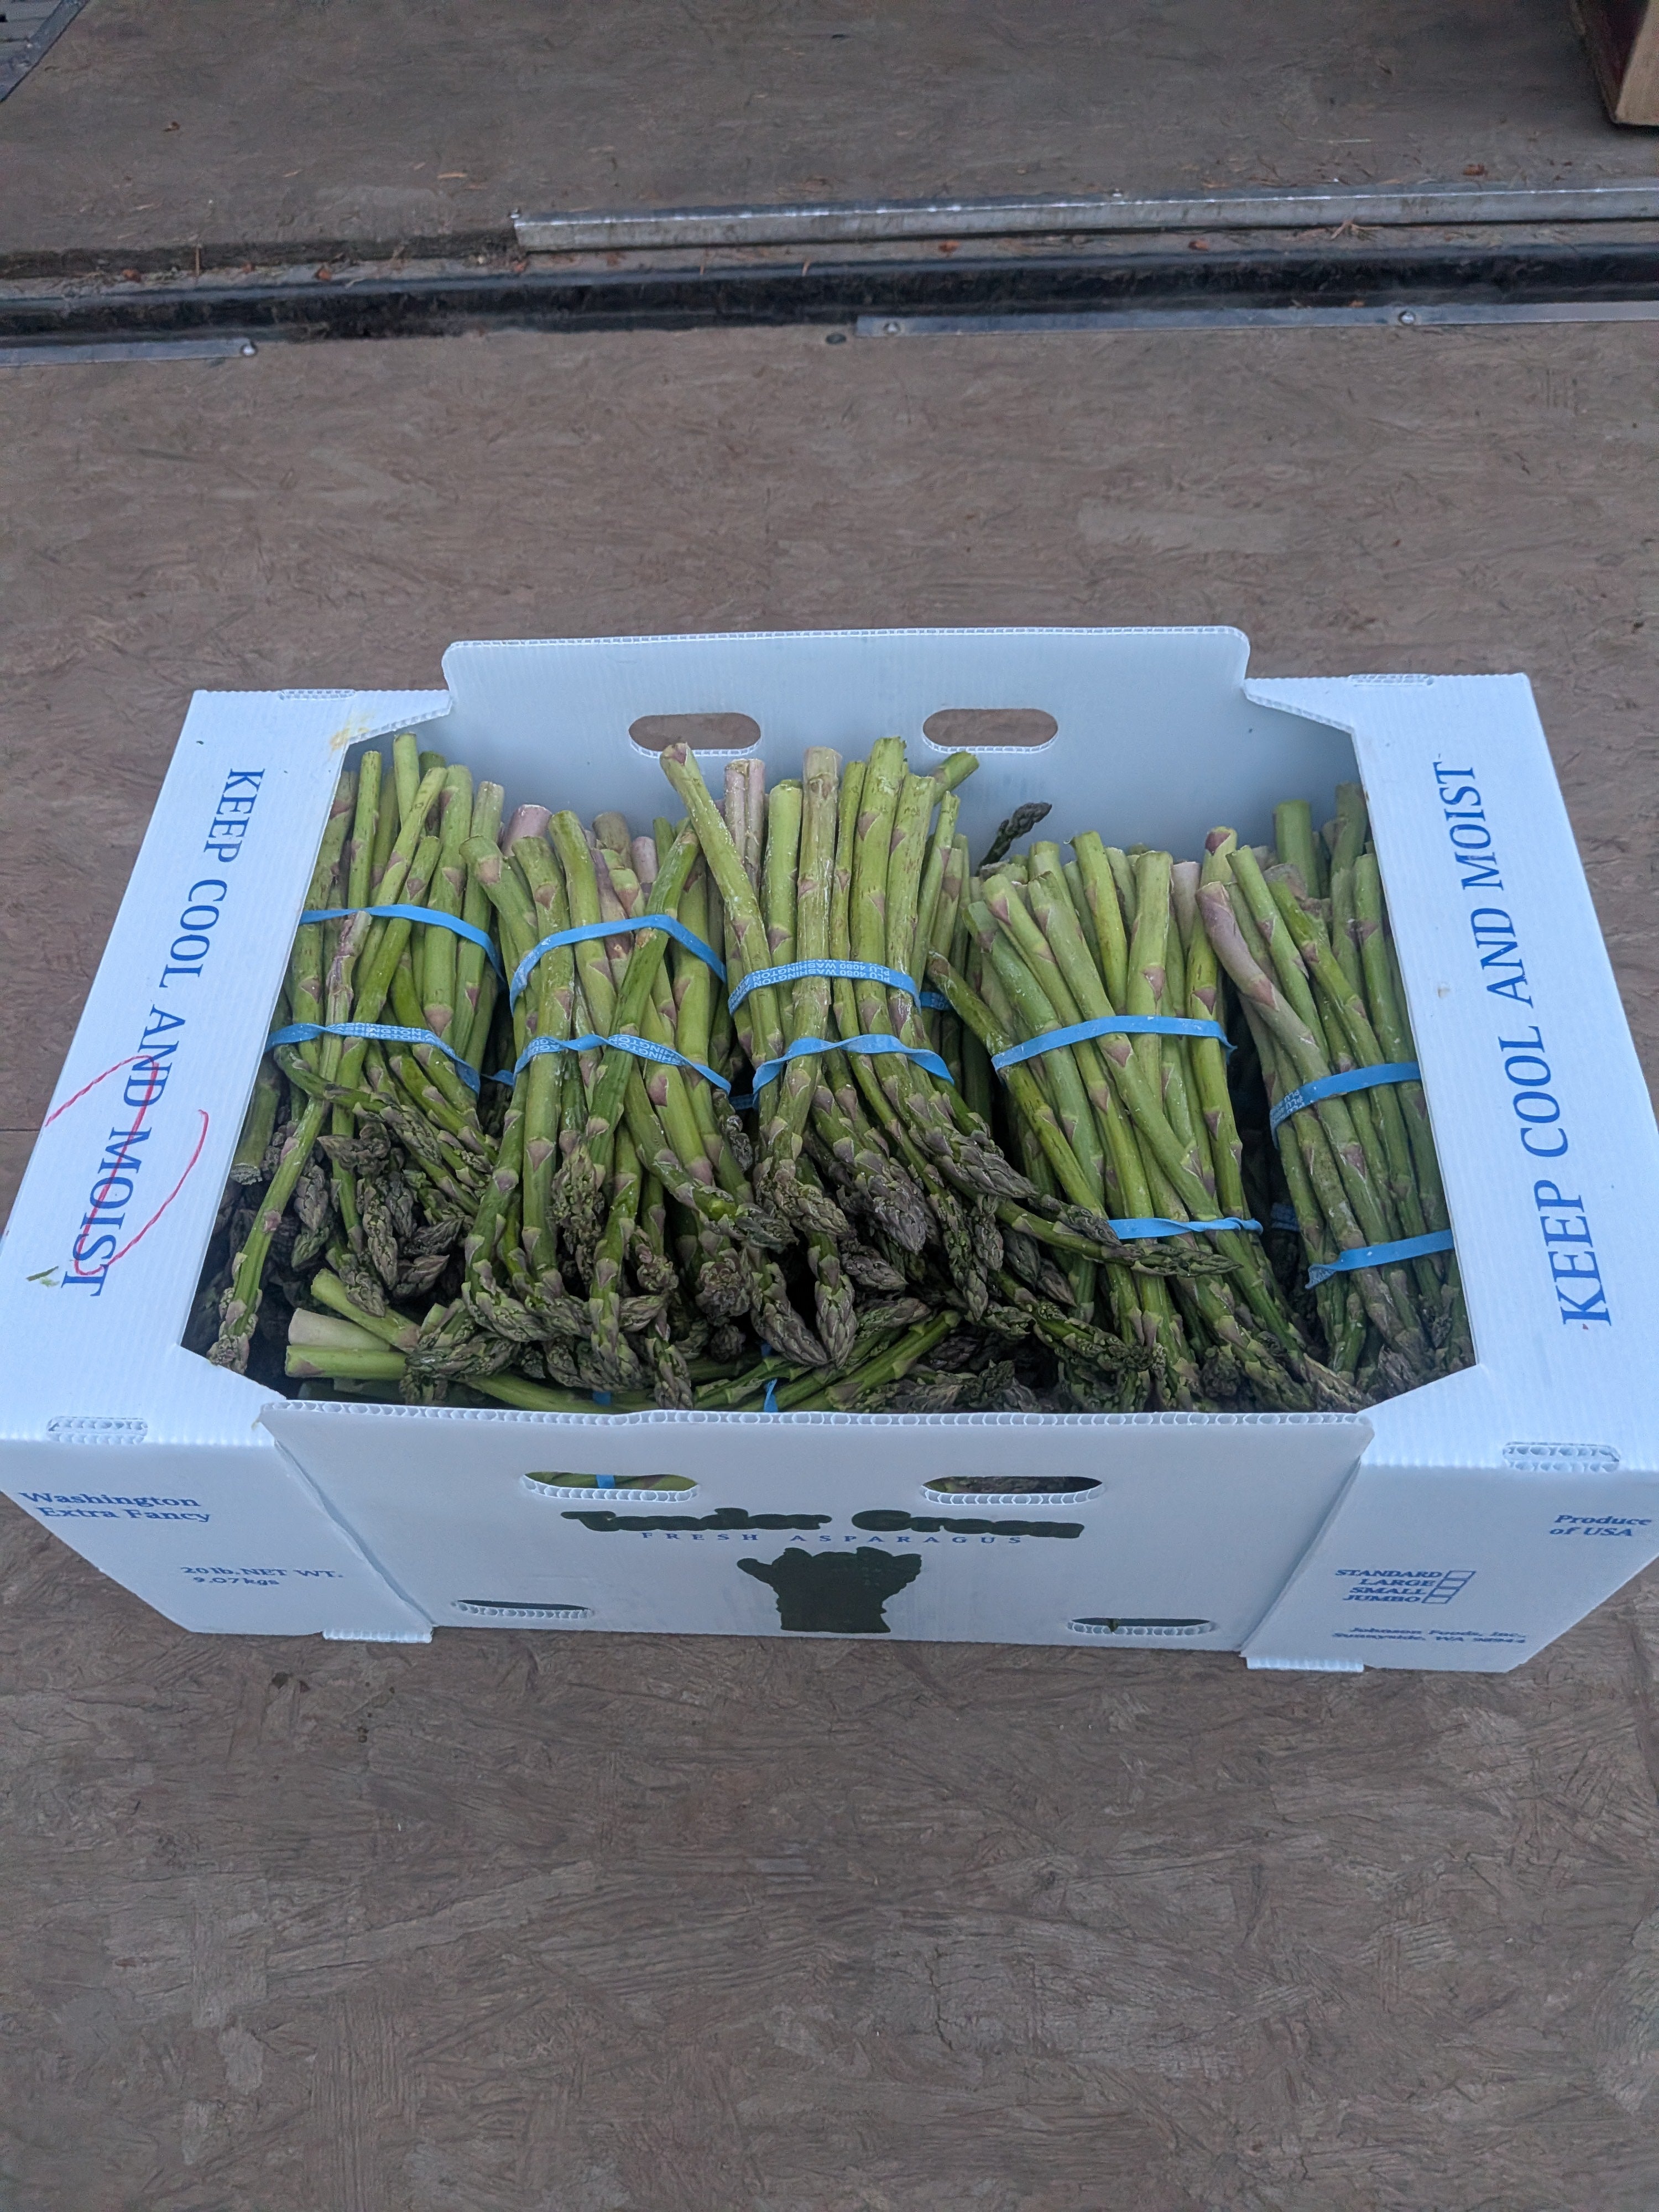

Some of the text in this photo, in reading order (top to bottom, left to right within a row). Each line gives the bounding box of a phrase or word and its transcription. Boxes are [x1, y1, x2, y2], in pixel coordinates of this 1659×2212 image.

[61, 768, 265, 1296] KEEP COOL AND MOIST
[1433, 754, 1611, 1326] KEEP COOL AND MOIST
[20, 1493, 201, 1507] Washington
[36, 1506, 210, 1523] Extra Fancy
[1554, 1515, 1652, 1526] Produce
[1549, 1527, 1634, 1536] of USA
[641, 1532, 1022, 1544] FRESH ASPARAGUS
[293, 1569, 343, 1578] WT.
[1335, 1569, 1442, 1578] STANDARD
[1359, 1578, 1437, 1587] LARGE
